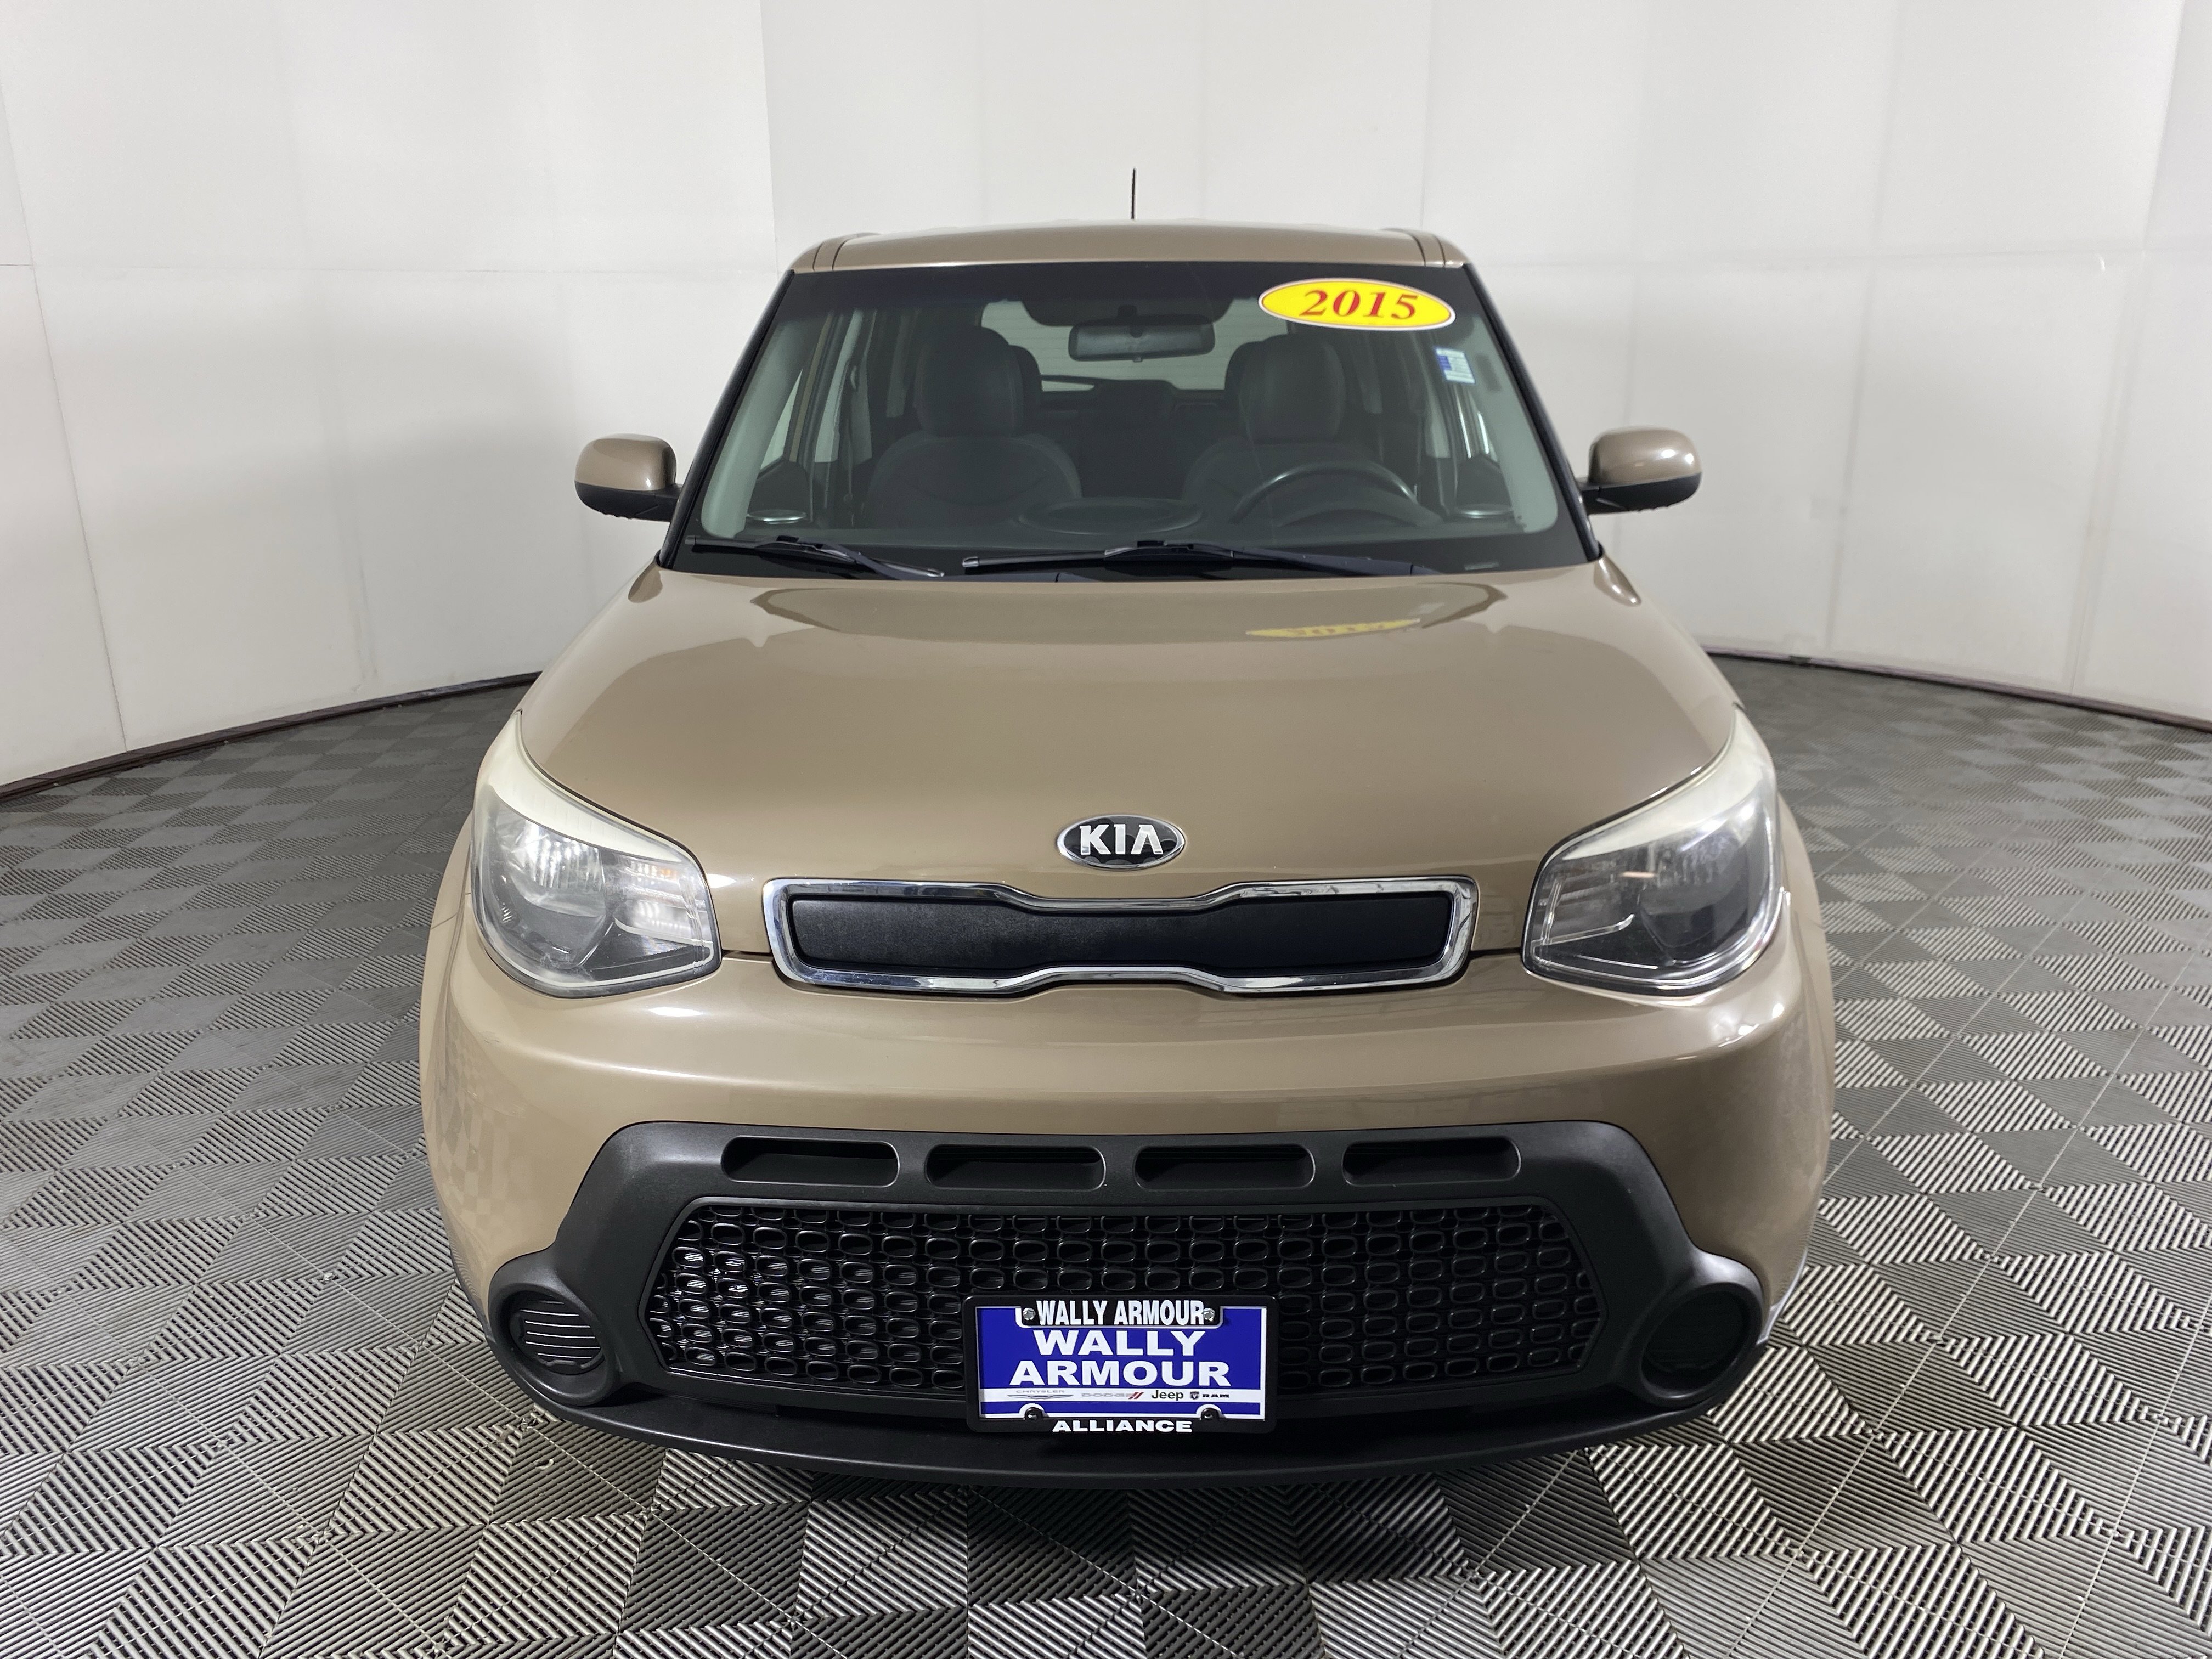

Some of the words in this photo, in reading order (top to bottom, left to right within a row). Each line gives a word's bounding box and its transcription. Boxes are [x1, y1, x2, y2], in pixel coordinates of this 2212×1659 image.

[1299, 290, 1419, 320] 2015
[1079, 823, 1164, 855] KIA
[1036, 1300, 1108, 1325] WALLY
[1113, 1299, 1205, 1325] ARMOUR
[1033, 1330, 1206, 1356] WALLY
[1009, 1360, 1232, 1386] ARMOUR
[1152, 1390, 1184, 1401] Jeep
[1052, 1420, 1192, 1432] ALLIANCE
